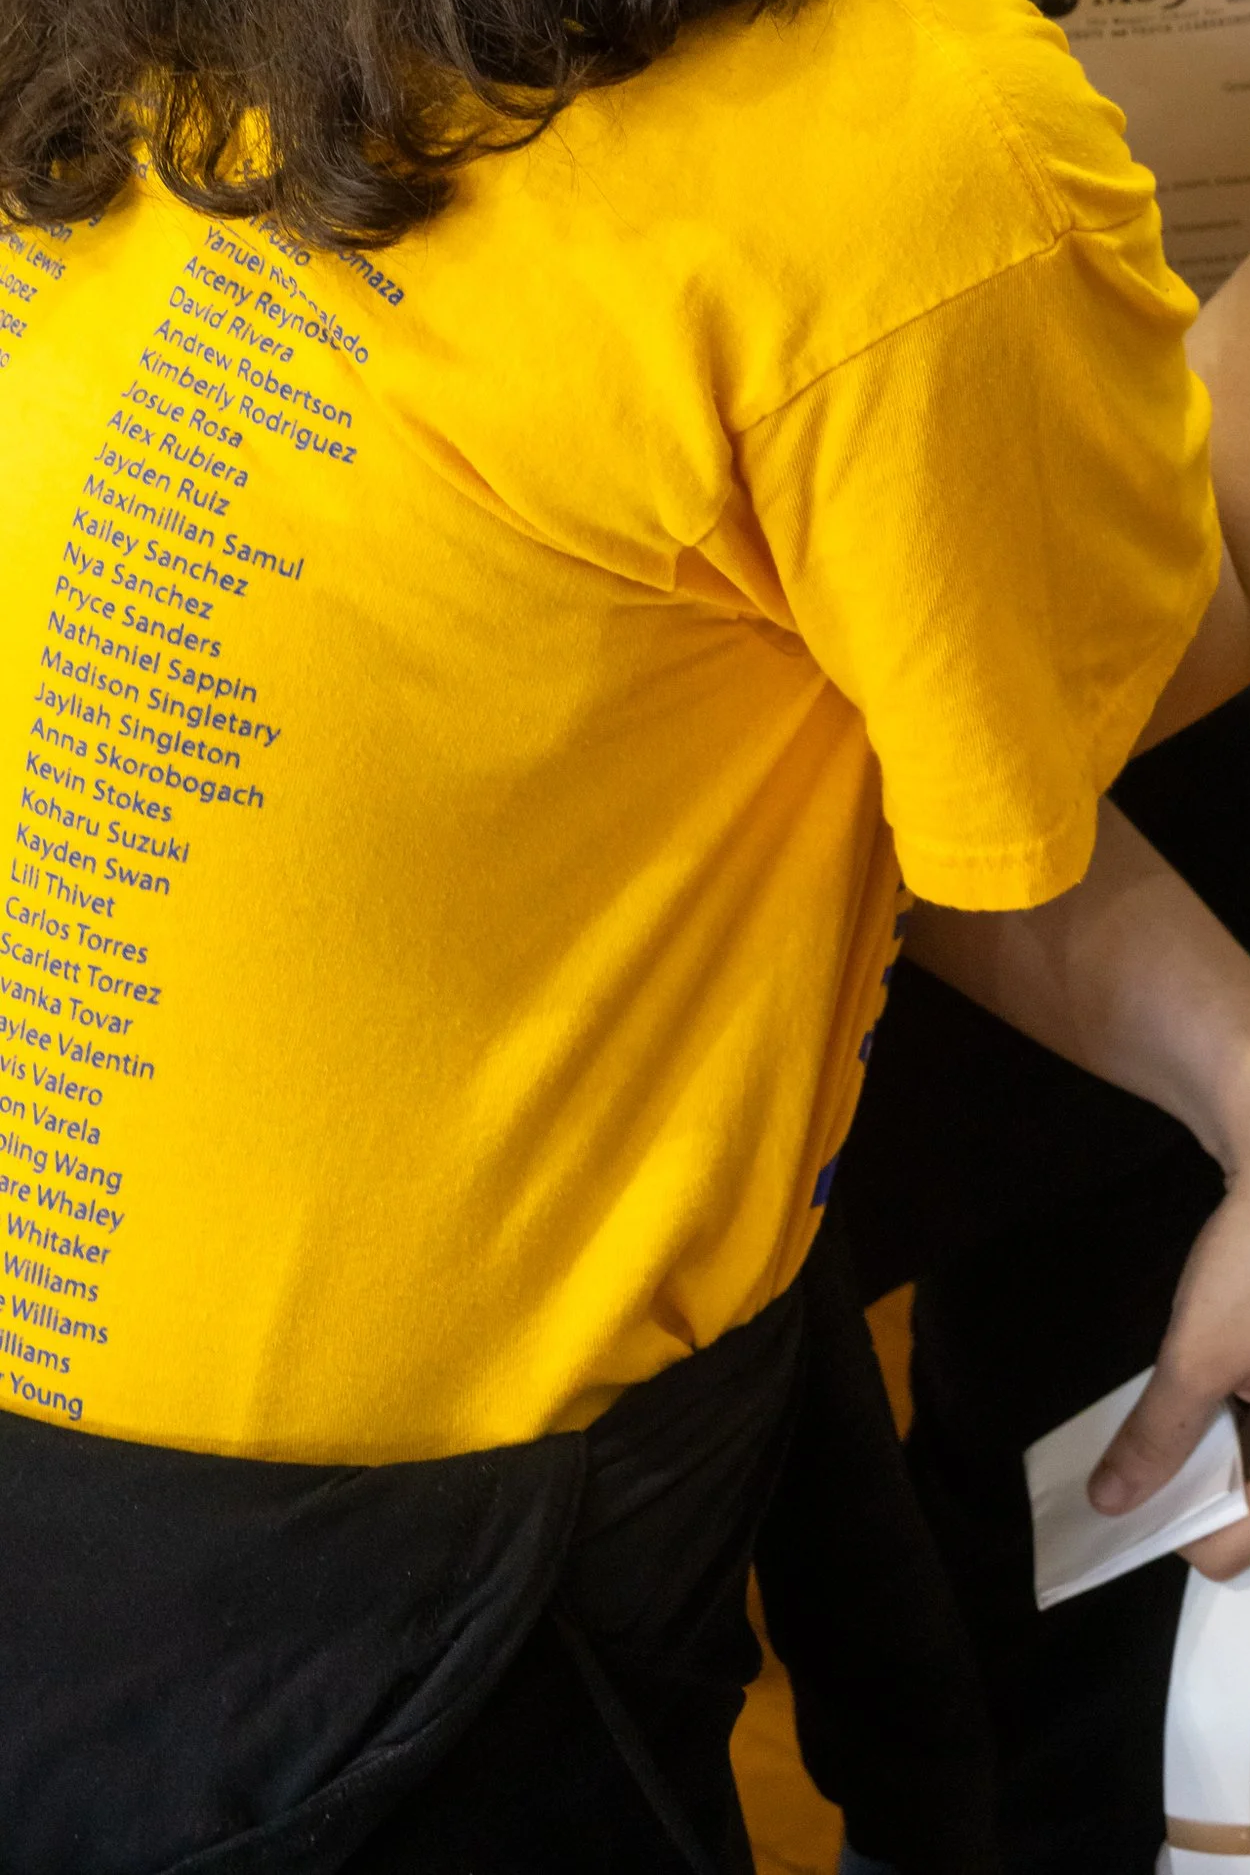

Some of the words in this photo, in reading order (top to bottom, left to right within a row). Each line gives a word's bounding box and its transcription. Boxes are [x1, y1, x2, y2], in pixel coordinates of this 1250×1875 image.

[184, 256, 253, 306] Arceny
[203, 225, 265, 275] Yanuel
[169, 286, 228, 329] David
[227, 316, 294, 362] Rivera
[139, 349, 236, 413] Kimberly
[239, 397, 357, 464] Rodriguez
[154, 320, 231, 371] Andrew
[237, 359, 353, 428] Robertson
[106, 410, 156, 445] Alex
[159, 435, 249, 488] Rubiera
[121, 380, 185, 423] Josue
[189, 408, 243, 448] Rosa
[93, 442, 169, 492] Jayden
[177, 479, 230, 516] Ruiz
[71, 507, 140, 556] Kailey
[144, 542, 249, 597] Sanchez
[82, 475, 214, 547] Maximillian
[223, 533, 304, 580] Samul
[55, 575, 116, 621] Pryce
[121, 600, 222, 658] Sanders
[62, 542, 105, 578] Nya
[111, 566, 214, 621] Sanchez
[47, 611, 161, 674] Nathaniel
[167, 658, 257, 703] Sappin
[33, 682, 111, 730] Jayliah
[118, 714, 241, 770] Singleton
[40, 645, 139, 703] Madison
[147, 688, 281, 748] Singletary
[25, 750, 85, 795] Kevin
[92, 778, 172, 823] Stokes
[30, 717, 88, 757] Anna
[94, 742, 265, 809] Skorobogach
[15, 822, 97, 874] Kayden
[103, 857, 171, 896] Swan
[20, 787, 100, 837] Koharu
[107, 820, 190, 864] Suzuki
[5, 896, 70, 941] Carlos
[76, 922, 148, 965] Torres
[46, 871, 116, 919] Thivet
[0, 932, 81, 984] Scarlett
[88, 964, 162, 1006] Torrez
[69, 997, 134, 1036] Tovar
[33, 1062, 103, 1107] Valero
[59, 1032, 155, 1080] Valentin
[33, 1102, 101, 1145] Varela
[0, 1131, 48, 1175] ling
[55, 1150, 122, 1195] Wang
[7, 1211, 111, 1266] Whitaker
[37, 1183, 125, 1234] Whaley
[4, 1251, 99, 1302] Williams
[12, 1294, 108, 1344] Williams
[10, 1371, 83, 1421] Young
